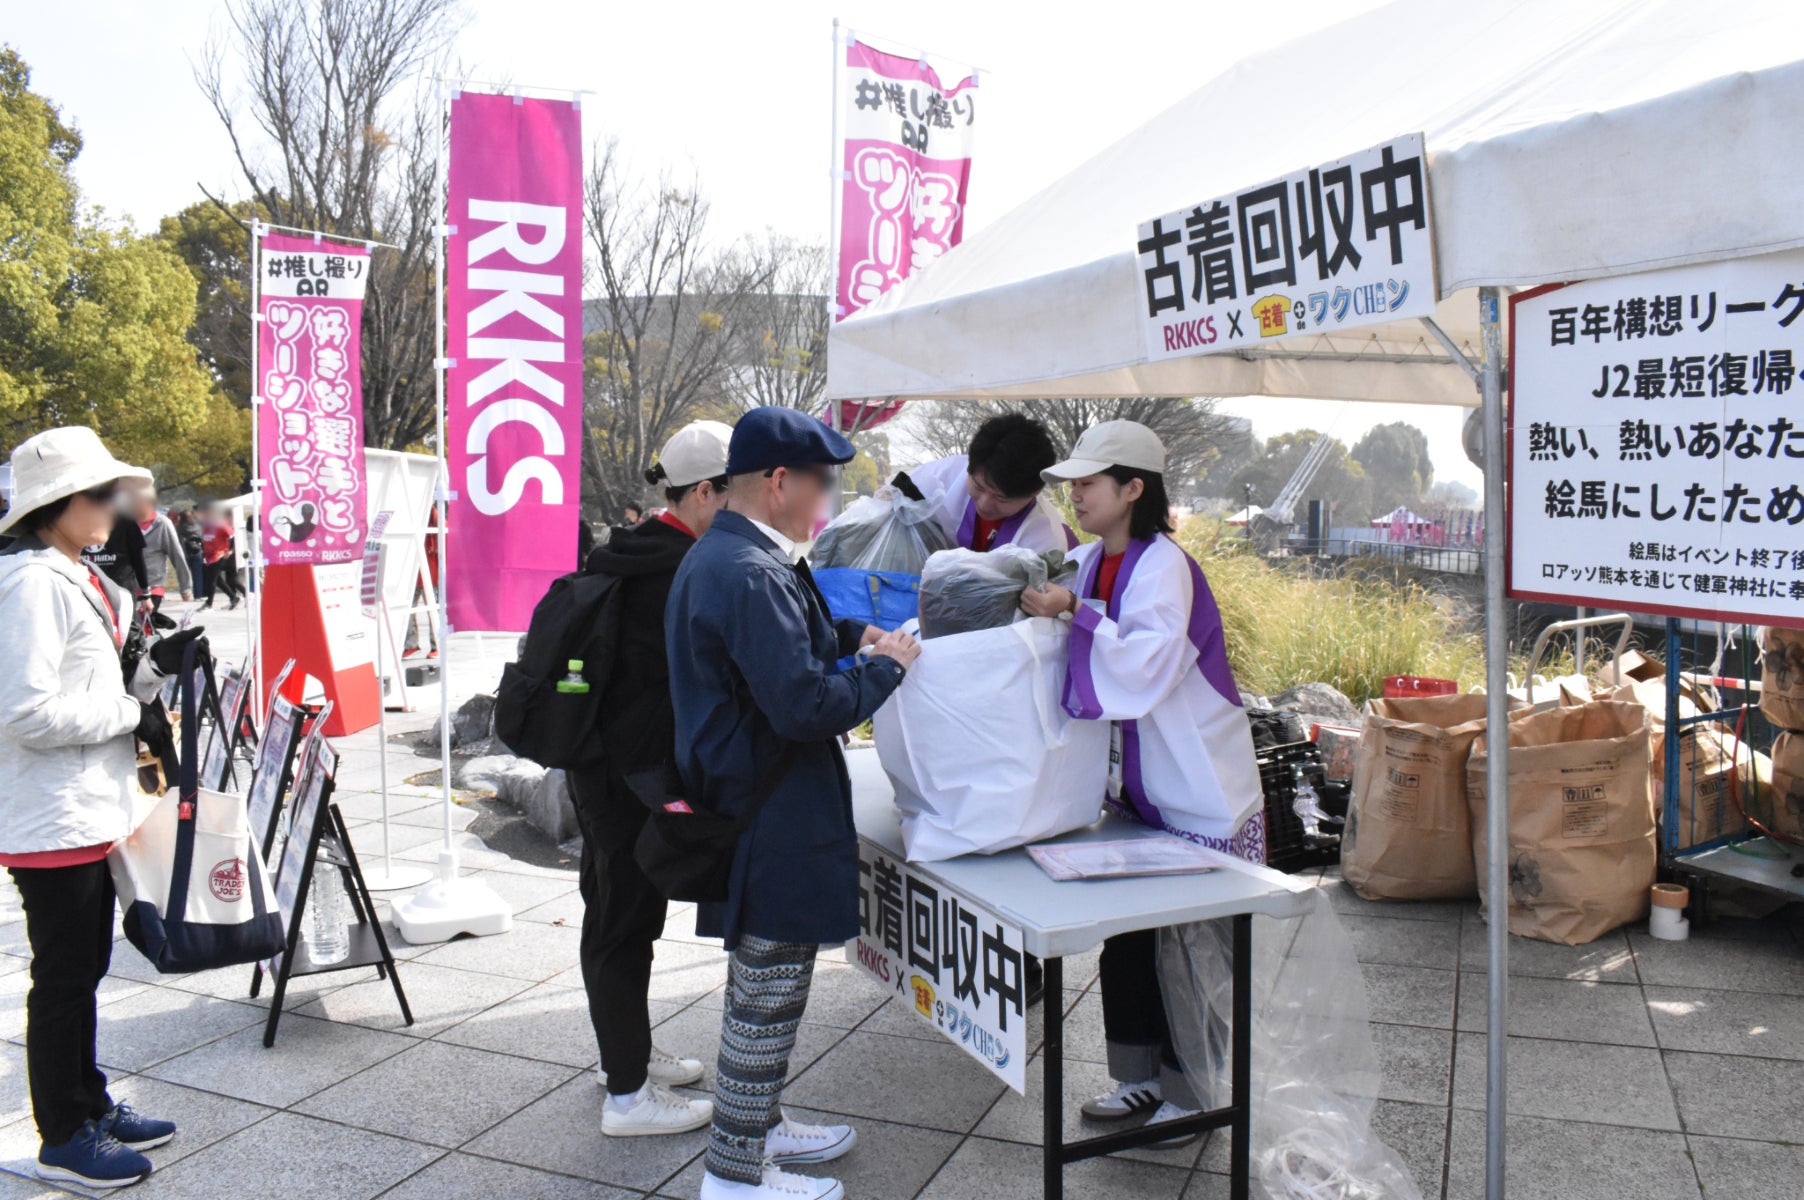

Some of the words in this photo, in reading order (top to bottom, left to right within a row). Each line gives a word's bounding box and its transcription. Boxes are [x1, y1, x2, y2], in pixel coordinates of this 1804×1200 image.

[855, 79, 975, 129] #推し撮り
[901, 120, 929, 154] AR
[1137, 145, 1426, 319] 古着回収中
[268, 254, 363, 280] #推し撮り
[296, 278, 329, 297] AR
[1163, 315, 1218, 351] RKKCS
[1260, 302, 1285, 330] 古着
[466, 197, 568, 517] RKKCS
[1592, 349, 1804, 400] J2最短復帰
[268, 304, 312, 500] ツーショット
[309, 309, 356, 528] 好きな選手と
[1529, 417, 1804, 461] 熱い、熱いあなた
[1545, 480, 1804, 525] 絵馬にしたため
[857, 938, 890, 983] RKKCS
